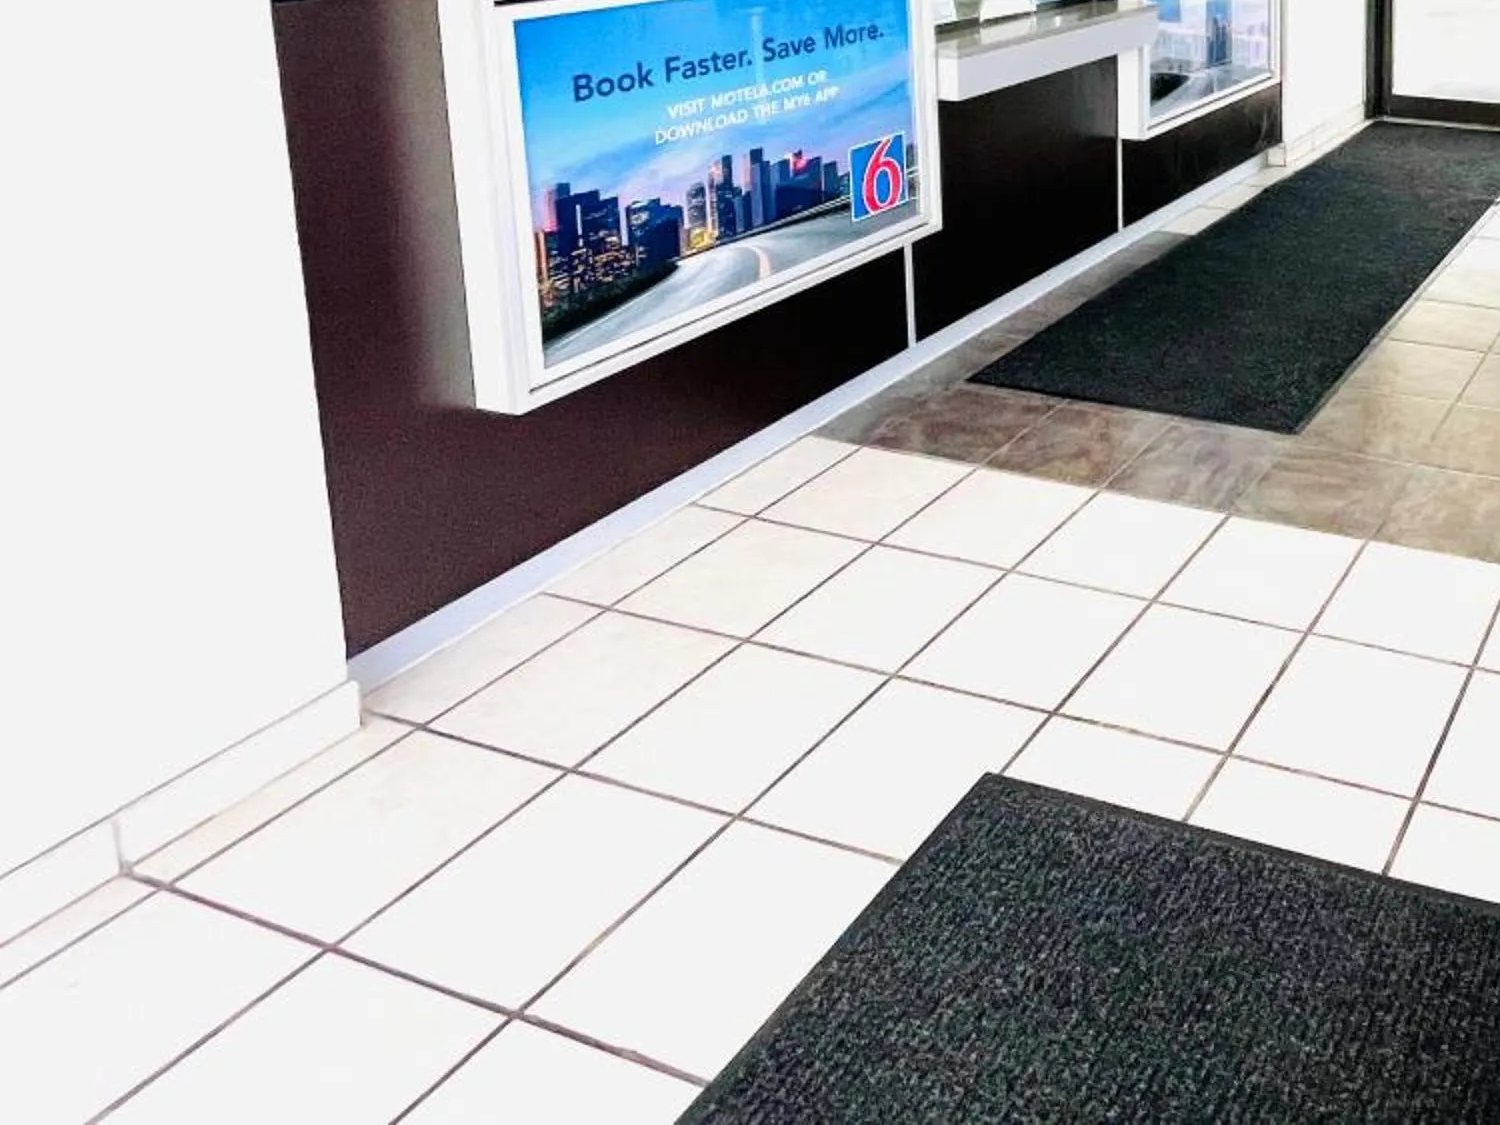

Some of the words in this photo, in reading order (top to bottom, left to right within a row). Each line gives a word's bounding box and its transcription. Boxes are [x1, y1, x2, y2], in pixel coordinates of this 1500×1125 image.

[572, 60, 655, 103] Book
[664, 49, 753, 83] Faster.
[762, 35, 816, 63] Save
[824, 23, 885, 50] More.
[667, 98, 705, 119] VISIT
[807, 70, 828, 86] OR
[655, 109, 749, 144] DOWNLOAD
[753, 100, 781, 120] THE
[815, 86, 840, 103] APP
[863, 137, 905, 216] 6
